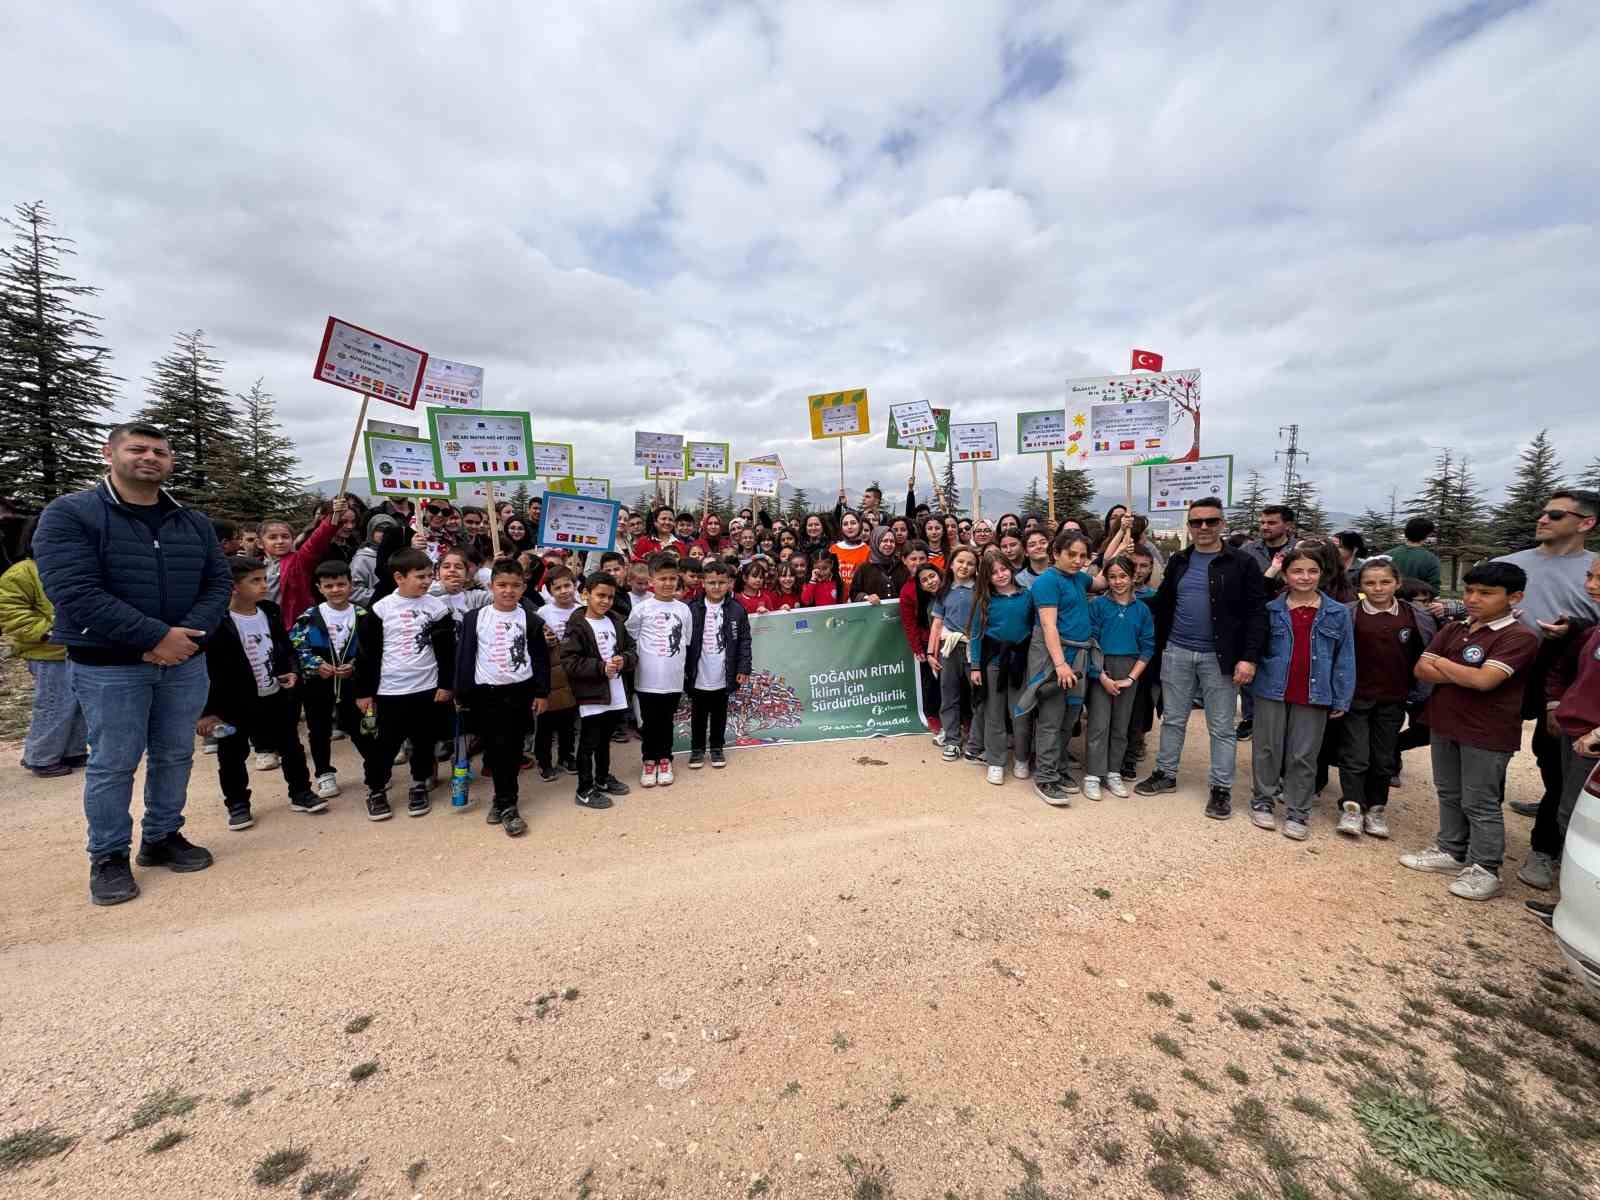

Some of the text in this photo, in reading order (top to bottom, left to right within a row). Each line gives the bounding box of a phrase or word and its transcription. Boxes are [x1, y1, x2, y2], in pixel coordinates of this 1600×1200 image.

[810, 660, 904, 685] DOĞANIN RİTMİ
[811, 681, 864, 699] İklim İçin
[811, 689, 906, 712] Sürdürülebilirlik
